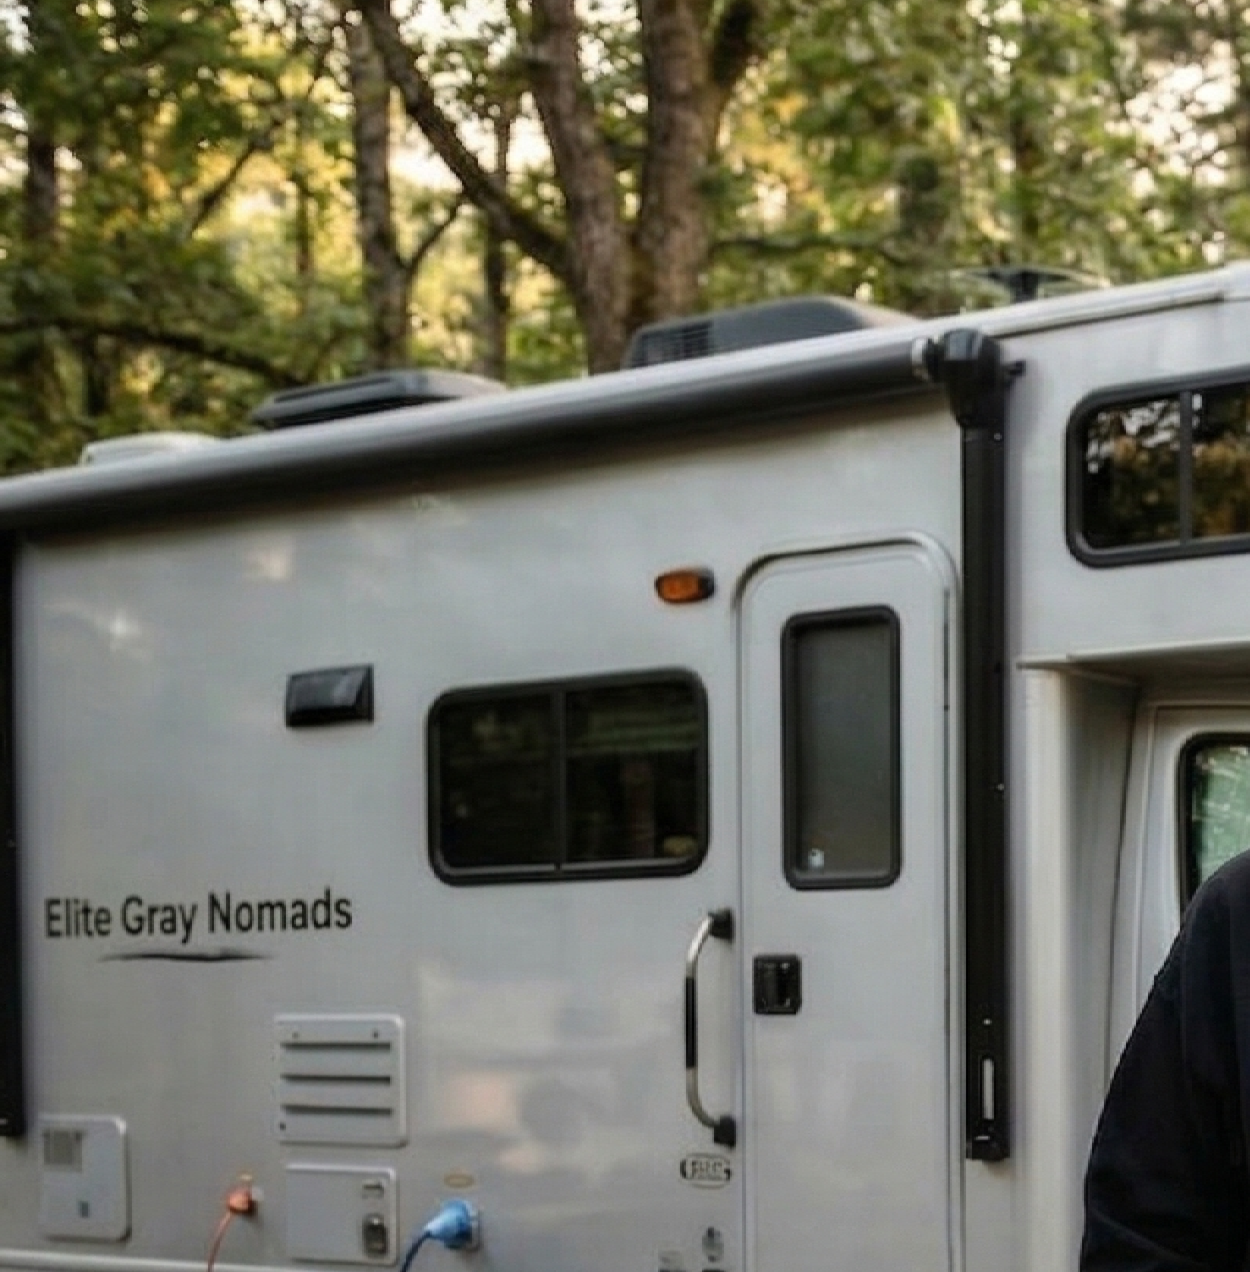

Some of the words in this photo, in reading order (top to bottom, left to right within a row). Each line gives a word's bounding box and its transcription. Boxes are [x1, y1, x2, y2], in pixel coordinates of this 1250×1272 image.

[45, 897, 112, 939] Elite
[121, 894, 198, 945] Gray
[208, 886, 353, 934] Nomads
